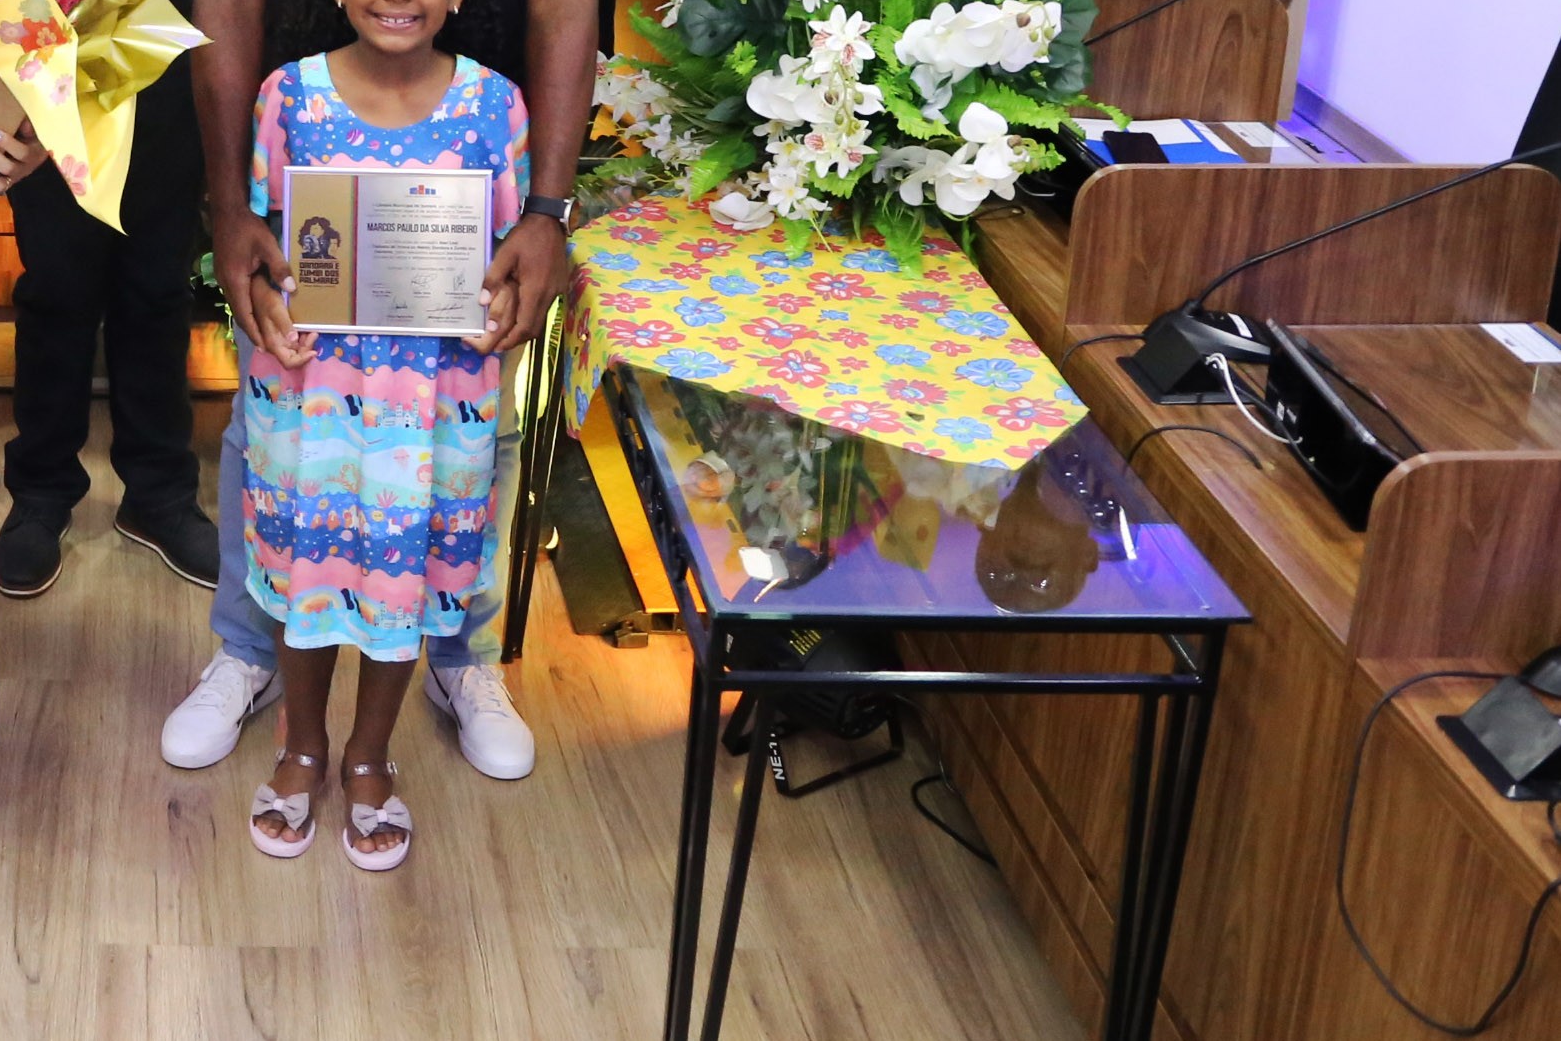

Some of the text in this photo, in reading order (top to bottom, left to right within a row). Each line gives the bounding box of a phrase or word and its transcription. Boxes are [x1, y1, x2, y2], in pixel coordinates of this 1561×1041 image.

[367, 223, 478, 234] MARCOS PAULO DA SILVA RIBEIRO
